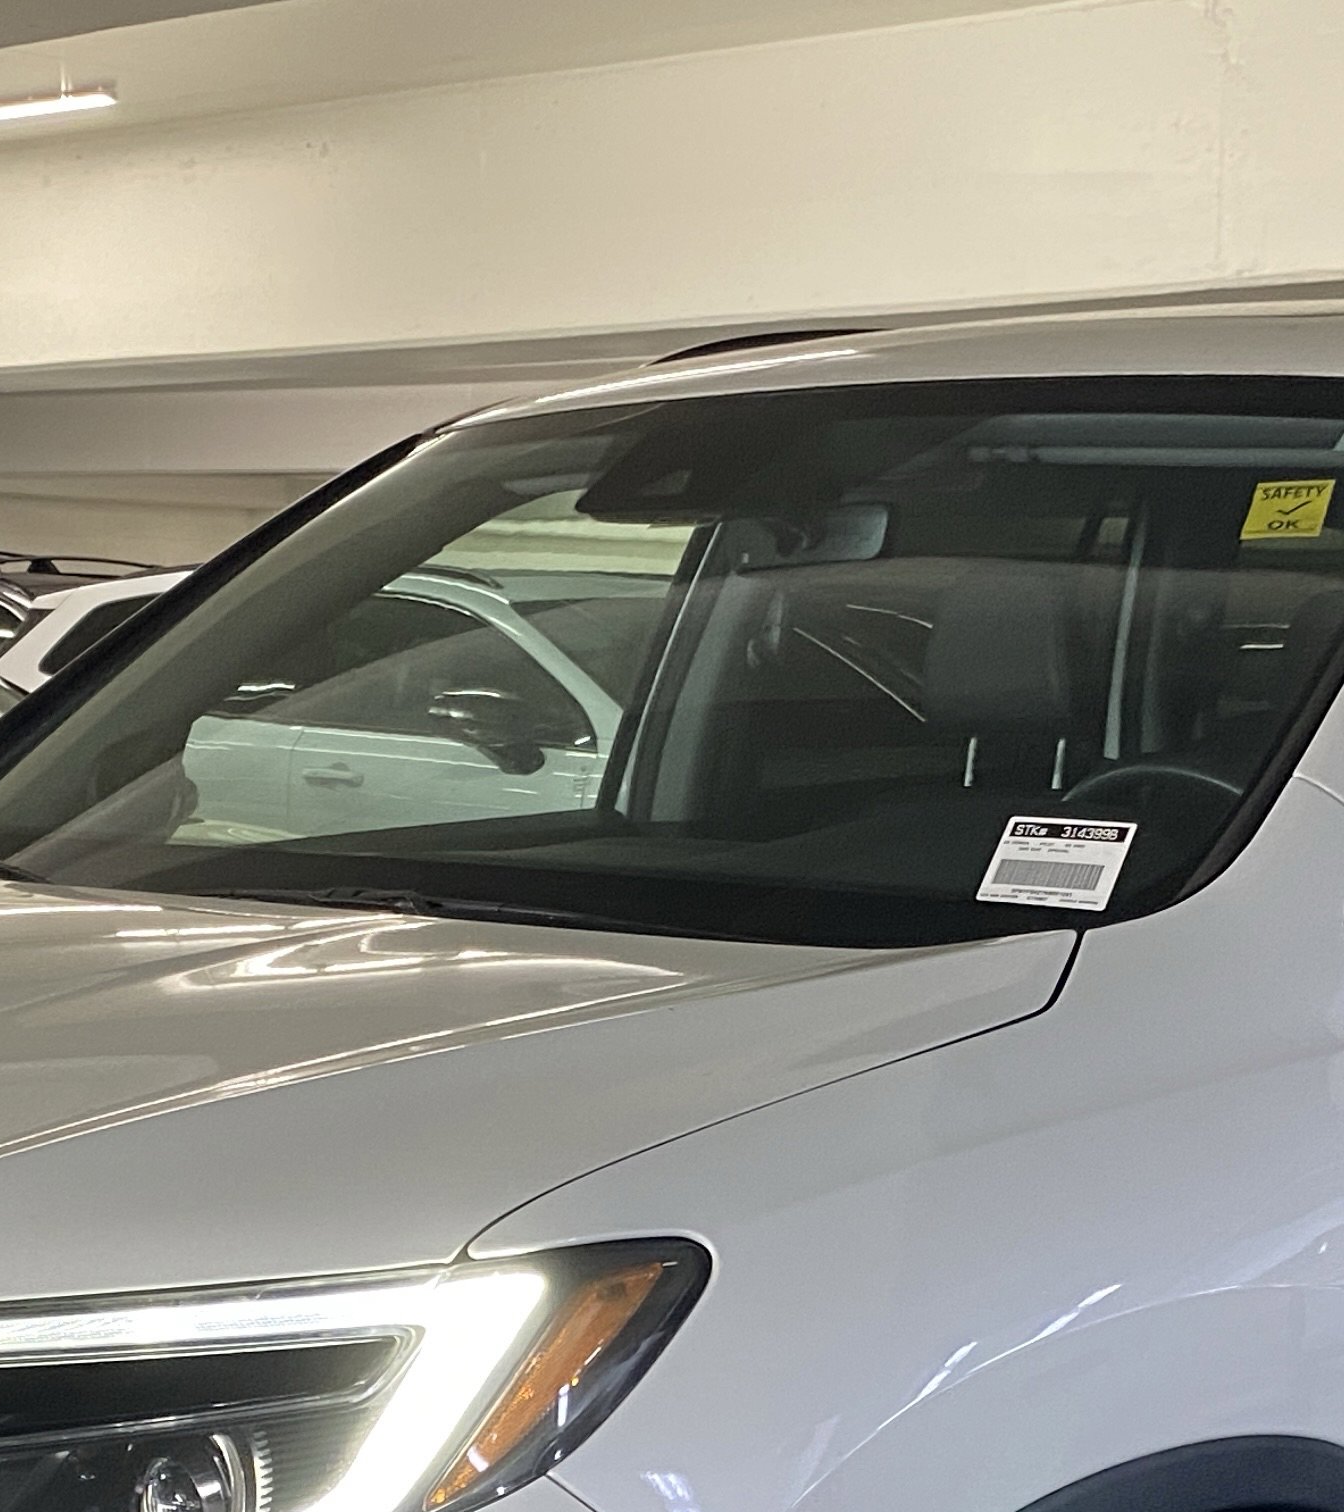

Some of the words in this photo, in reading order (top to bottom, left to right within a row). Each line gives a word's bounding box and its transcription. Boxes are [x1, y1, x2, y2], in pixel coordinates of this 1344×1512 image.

[1261, 485, 1329, 500] SAFETY
[1267, 519, 1300, 531] OK
[1014, 823, 1049, 837] STK#
